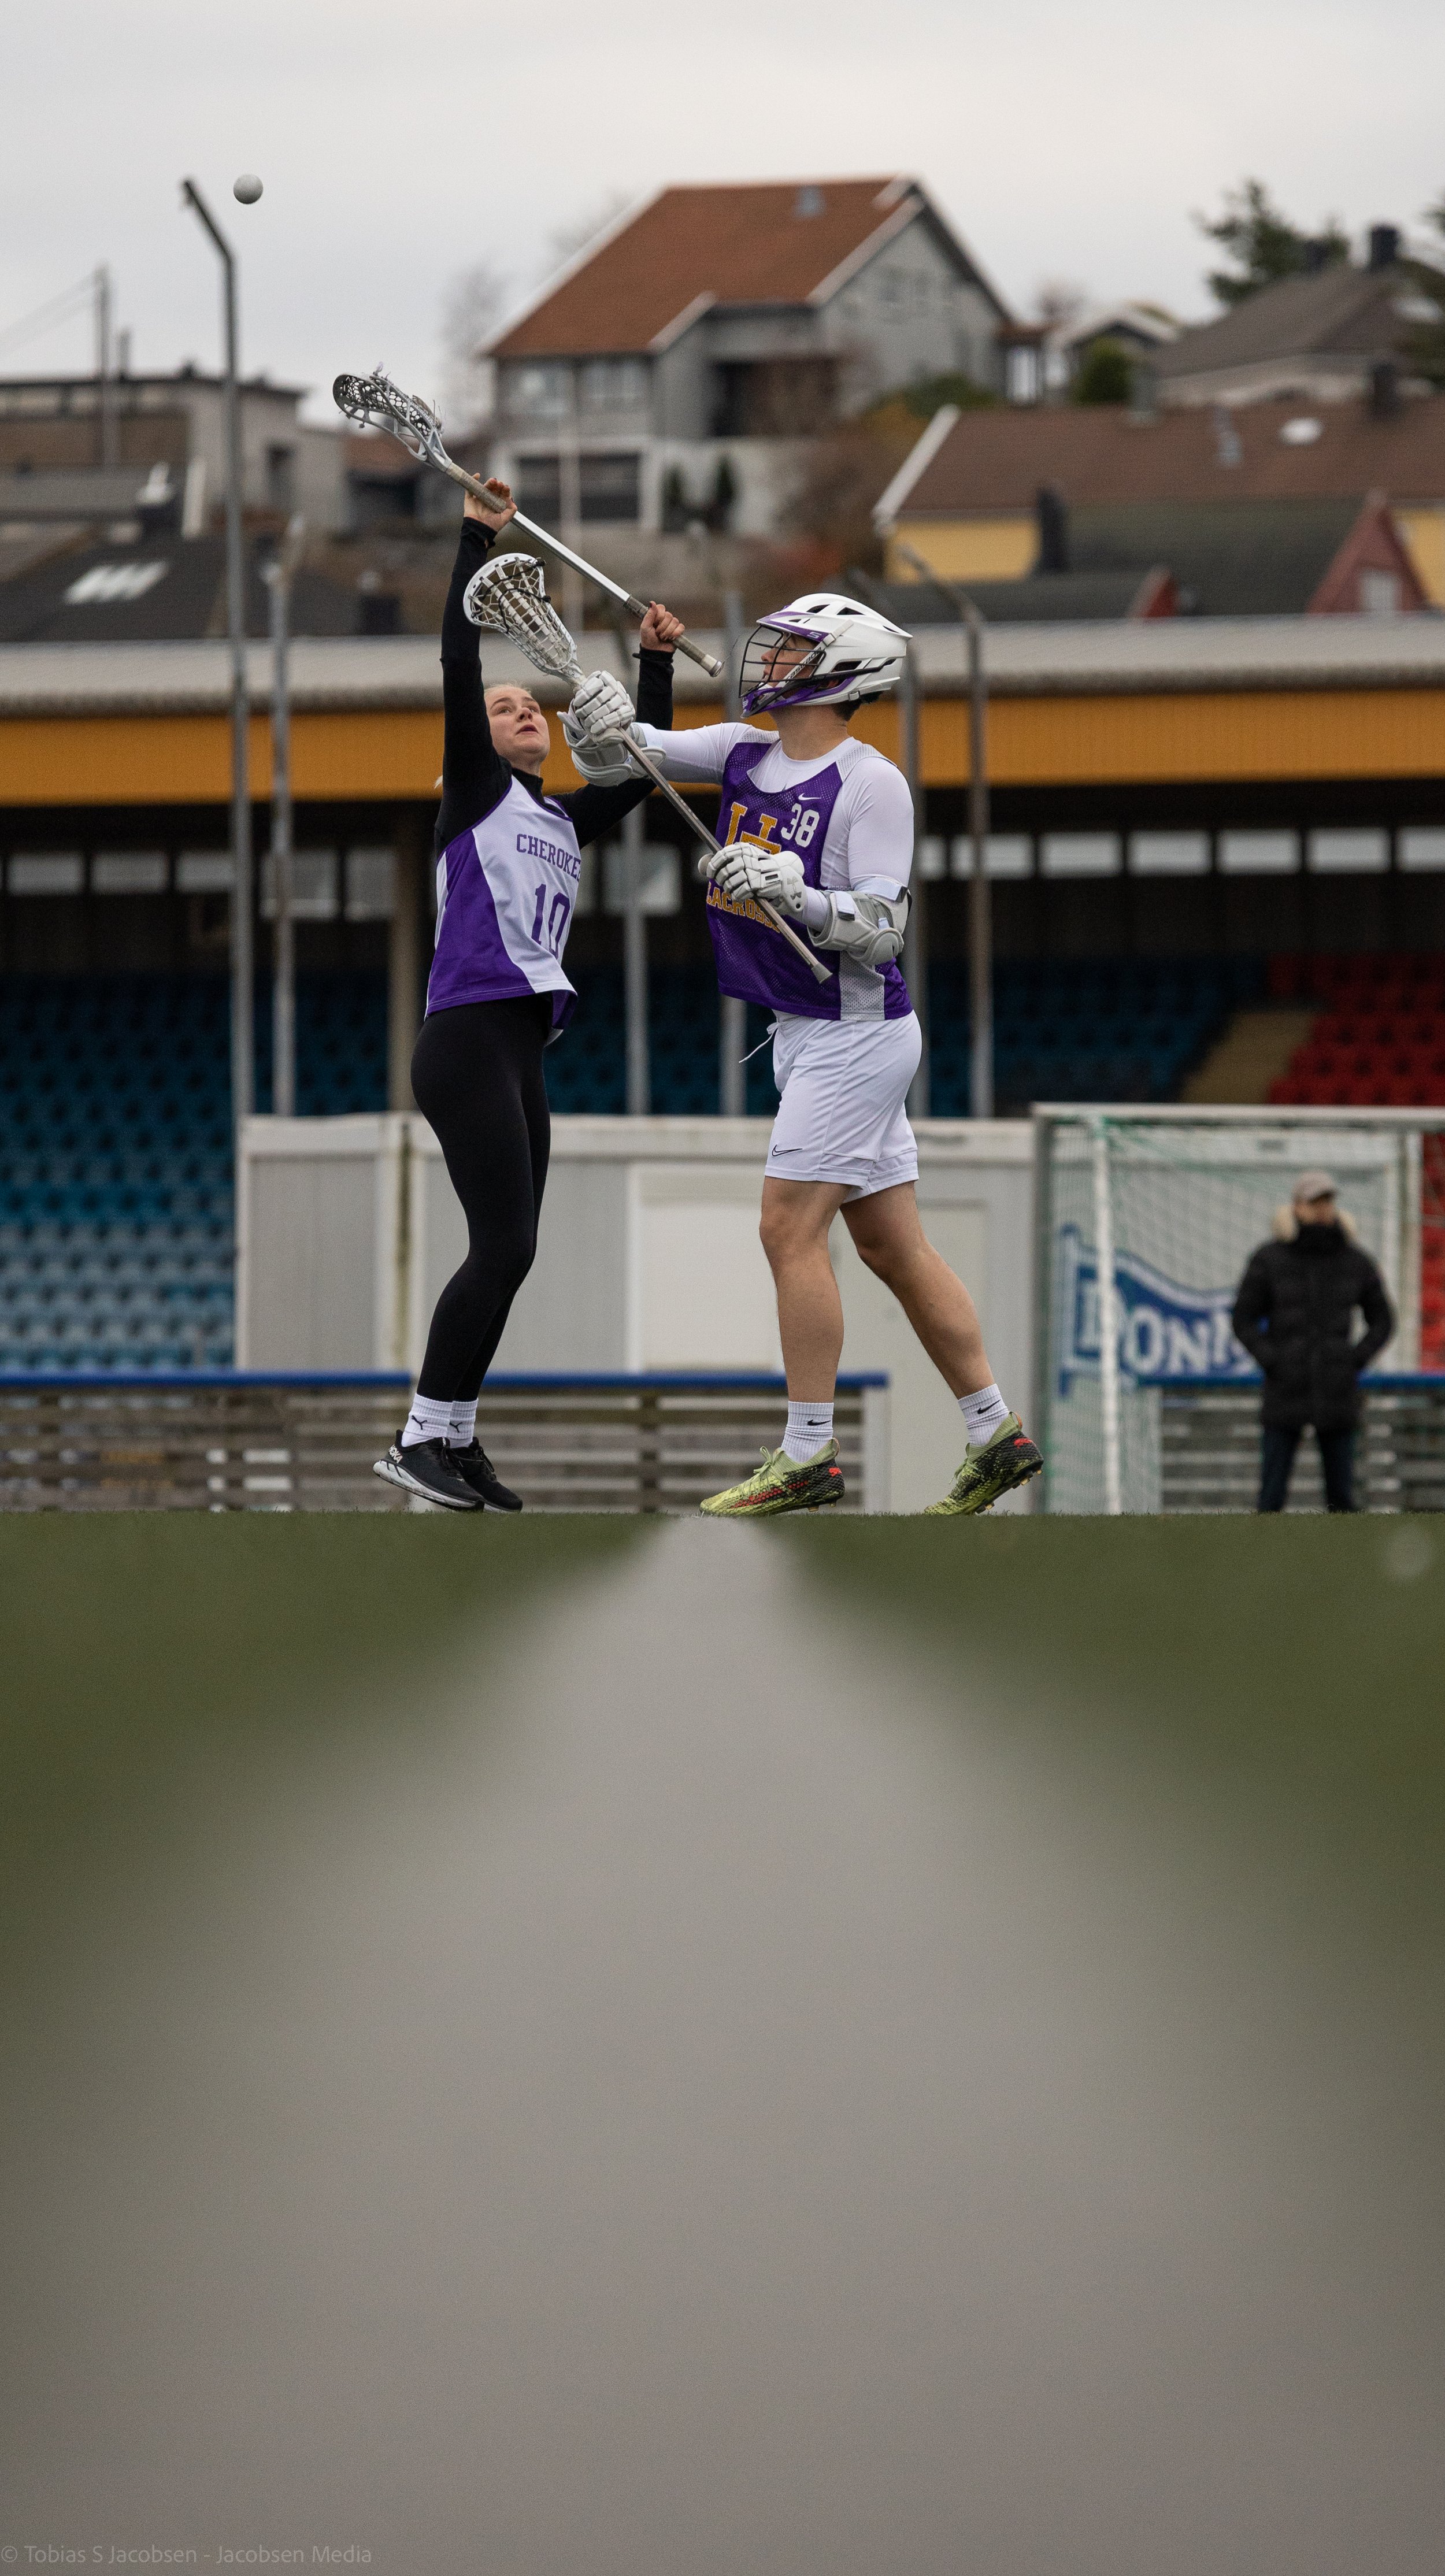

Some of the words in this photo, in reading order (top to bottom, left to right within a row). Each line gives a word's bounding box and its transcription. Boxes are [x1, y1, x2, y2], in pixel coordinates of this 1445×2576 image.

[781, 803, 820, 848] 38
[516, 833, 581, 883] CHEROKE
[531, 883, 570, 959] 10
[706, 881, 780, 933] LACROS
[388, 1444, 403, 1464] HOKA
